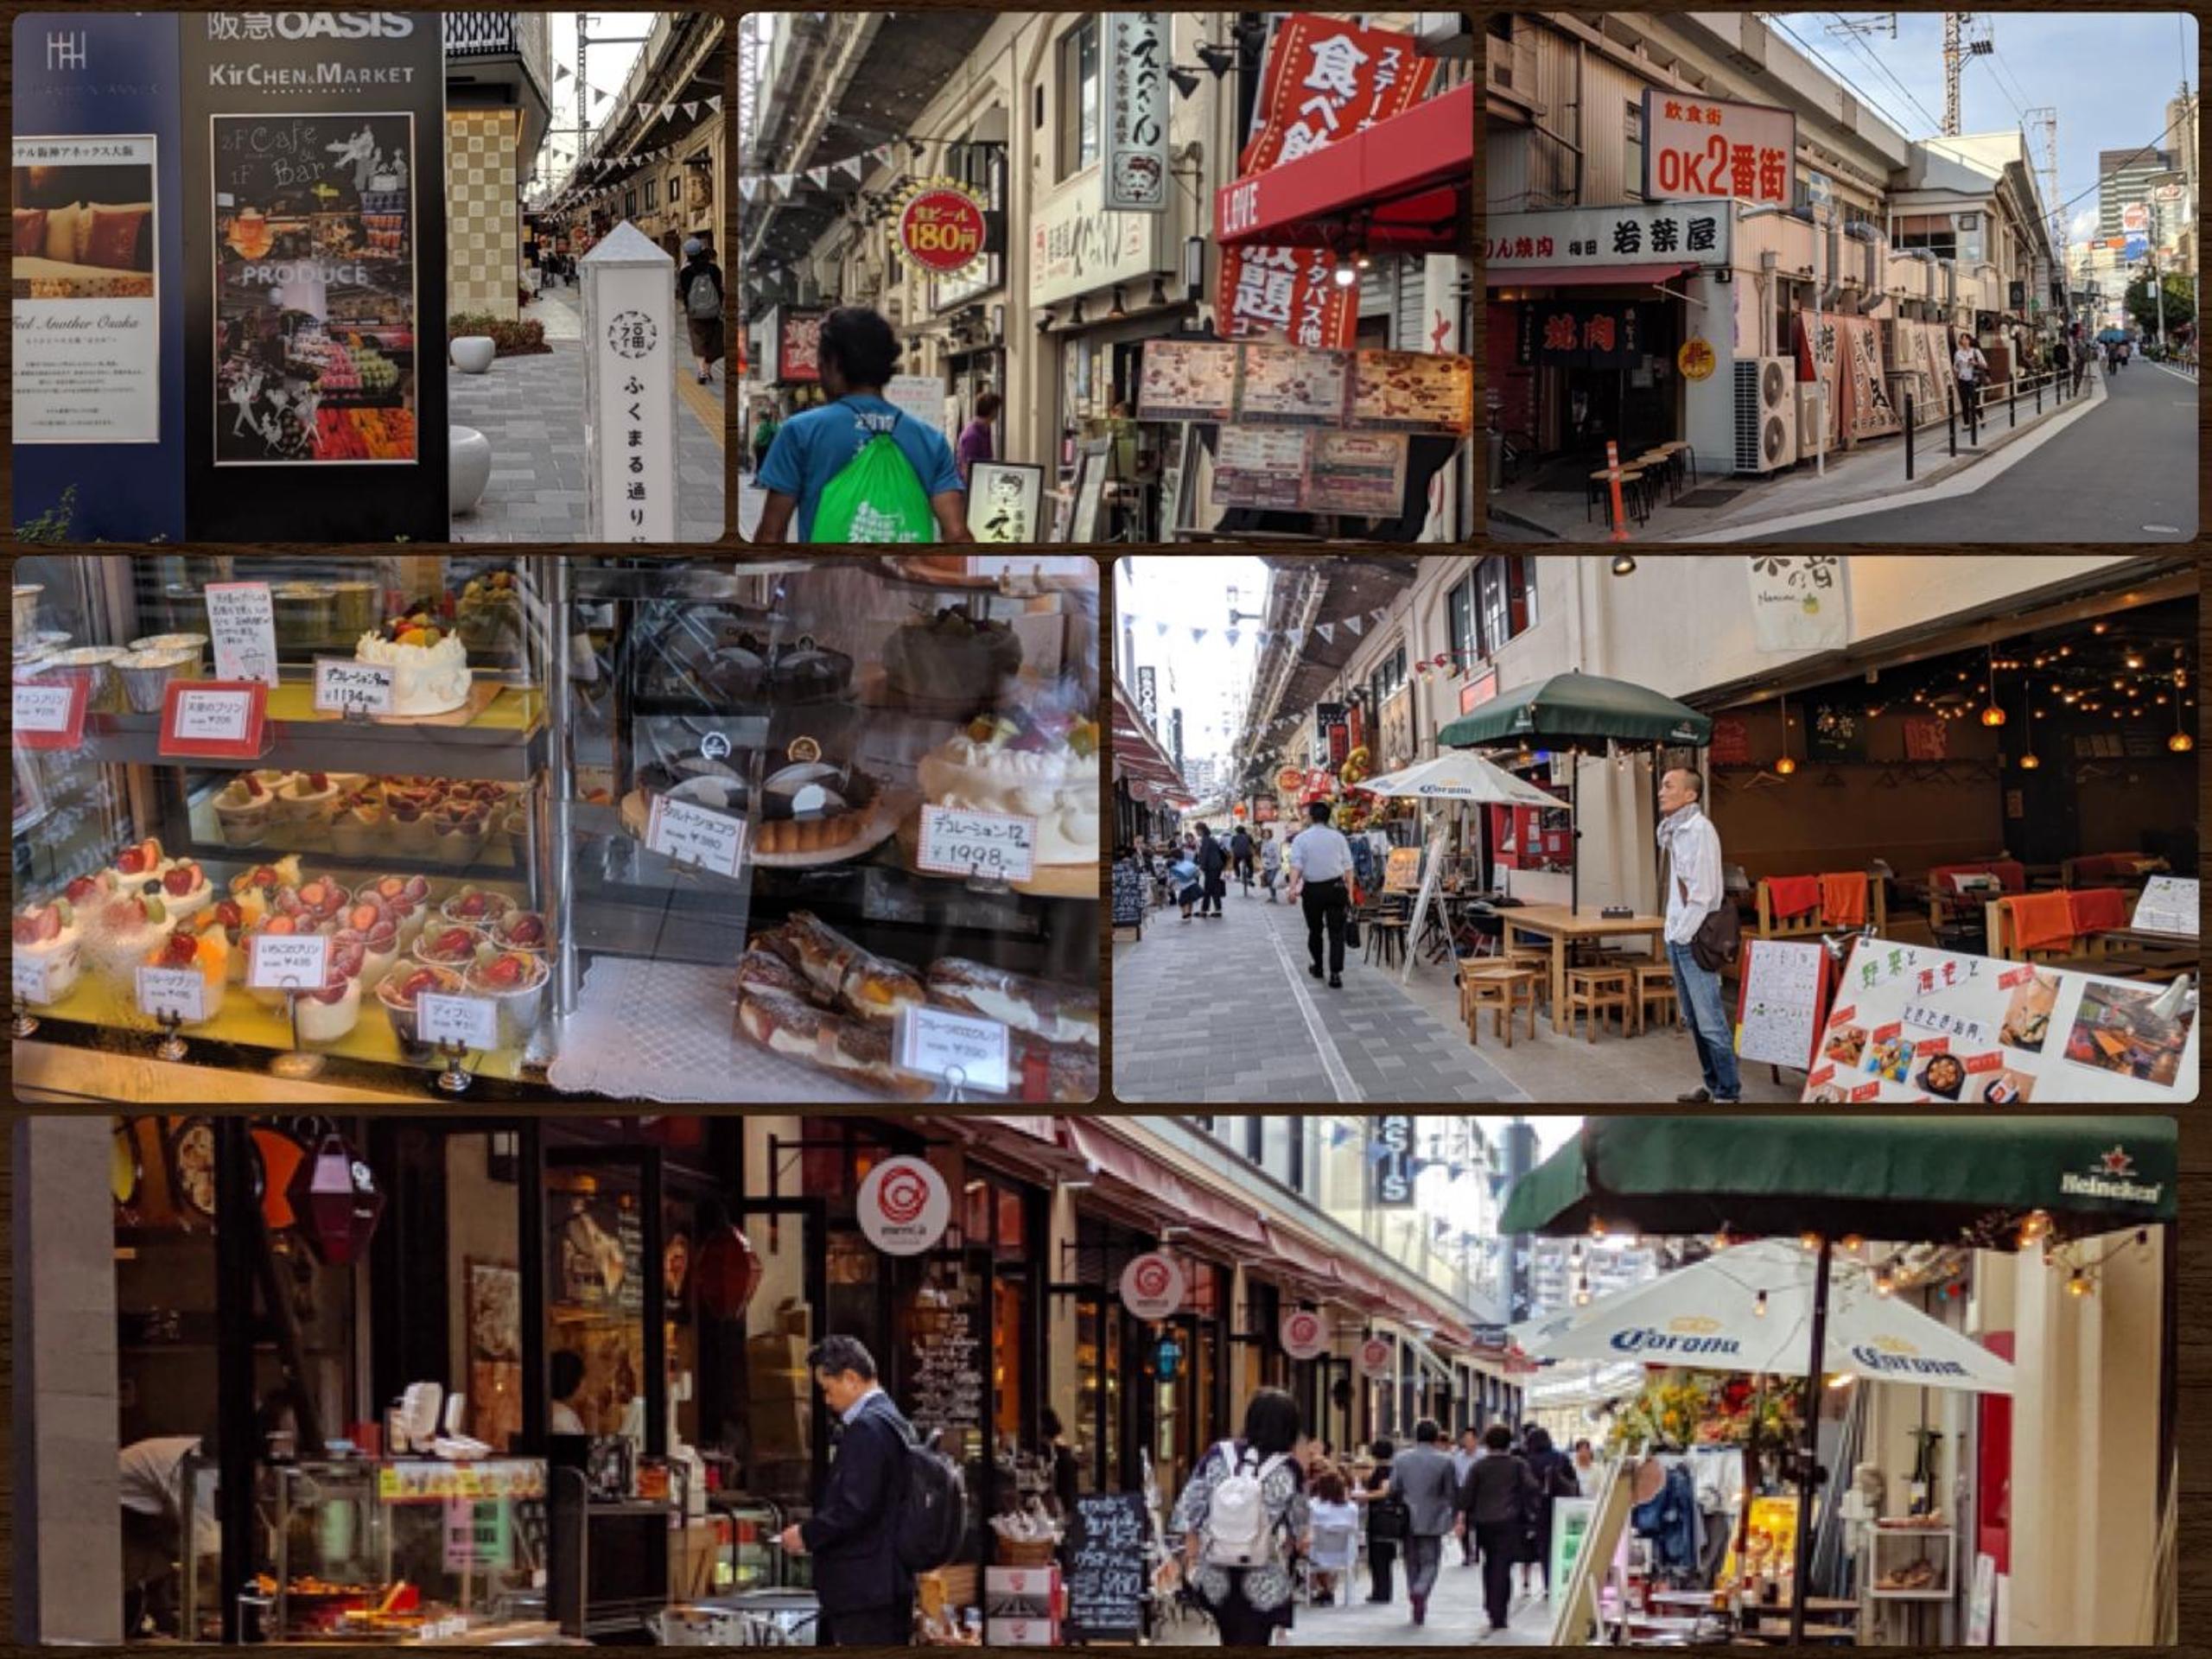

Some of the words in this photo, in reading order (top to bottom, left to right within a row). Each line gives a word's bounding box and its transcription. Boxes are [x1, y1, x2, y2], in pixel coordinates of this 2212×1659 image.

[1664, 100, 1723, 126] 飲食街
[1658, 134, 1786, 201] OK2番街
[906, 223, 978, 253] 180円
[1612, 216, 1717, 254] 若葉屋
[242, 264, 369, 285] PRODUCE
[37, 315, 92, 330] Another
[97, 314, 139, 329] Osaka
[2060, 1171, 2160, 1205] Heineken
[1609, 1326, 1741, 1355] Corona
